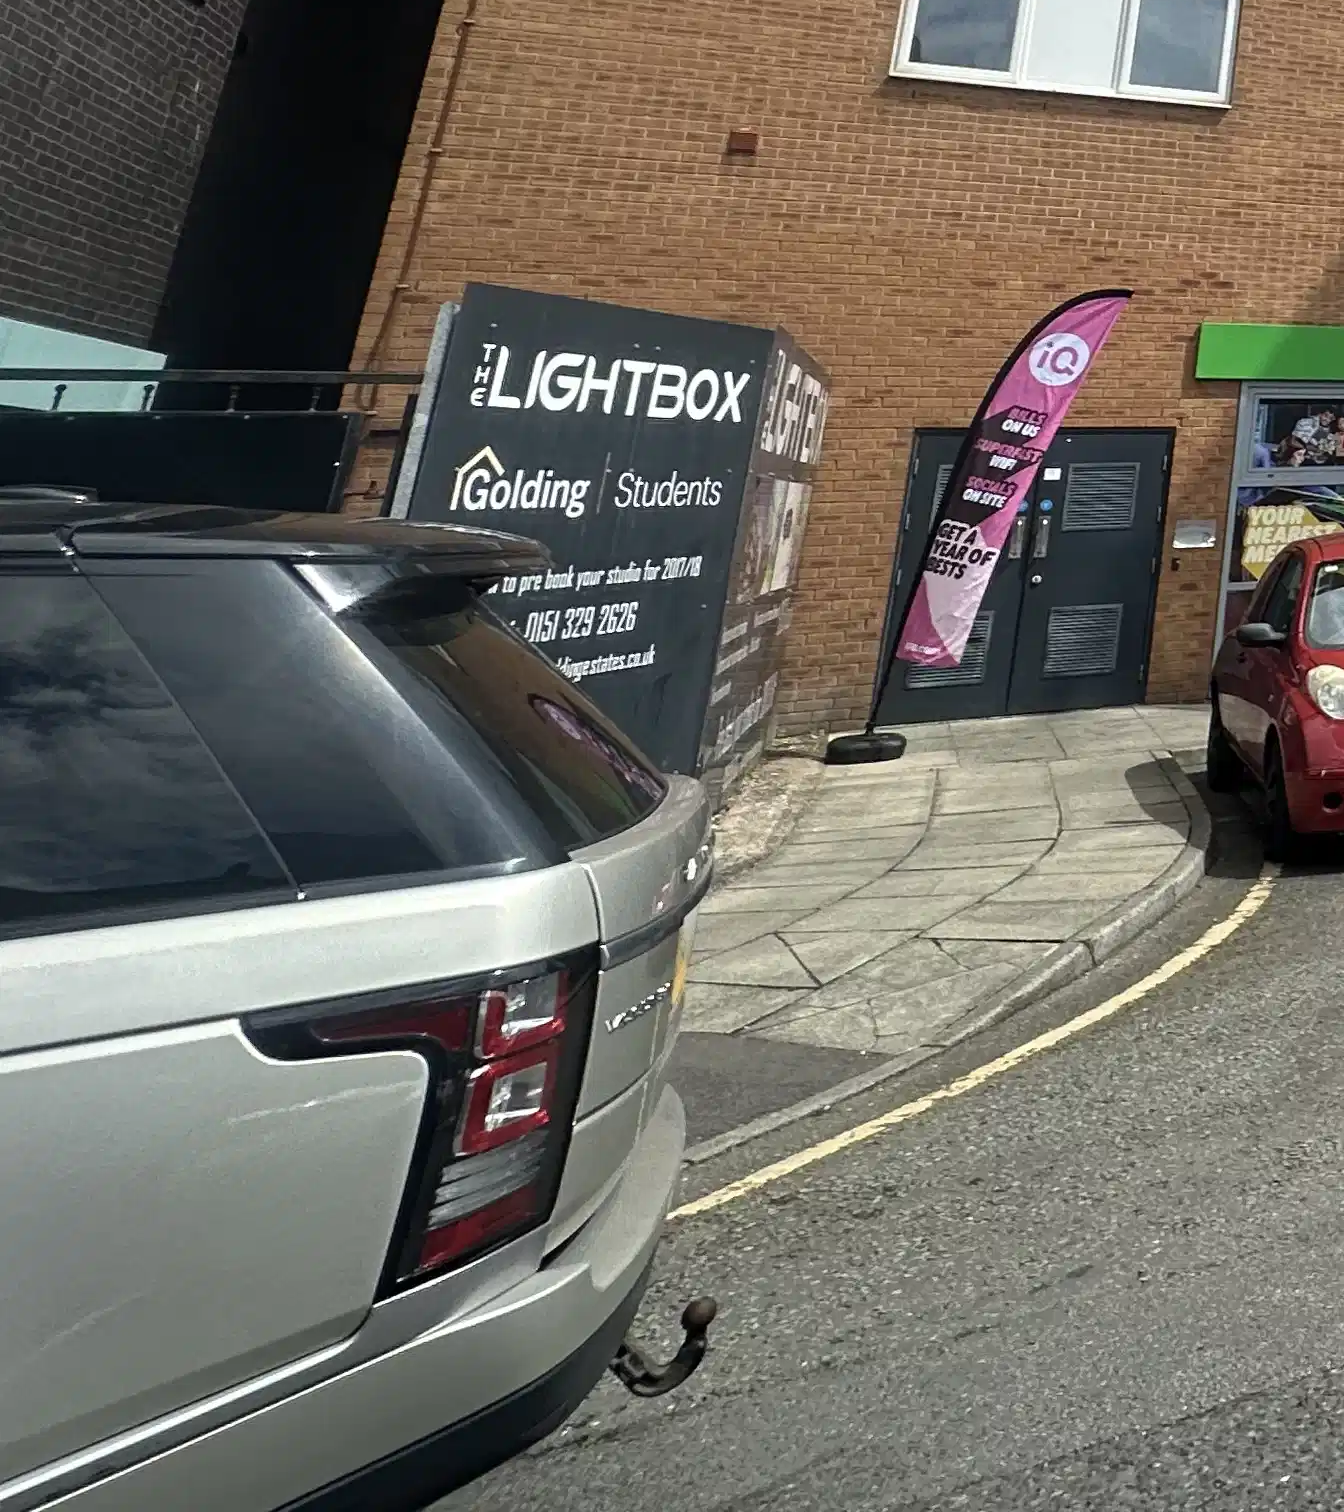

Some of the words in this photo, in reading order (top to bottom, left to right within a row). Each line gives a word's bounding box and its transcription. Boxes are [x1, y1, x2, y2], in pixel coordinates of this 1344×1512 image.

[1036, 340, 1080, 377] iQ
[469, 342, 497, 407] THE
[487, 345, 751, 423] LIGHTBOX
[1001, 419, 1025, 434] ON
[1020, 423, 1041, 438] US
[462, 468, 591, 519] Golding
[613, 470, 723, 508] Students
[978, 491, 1008, 508] SITE
[1247, 506, 1305, 526] YOUR
[937, 522, 968, 542] GET
[962, 529, 978, 546] A
[1245, 524, 1338, 545] NEAREST
[932, 539, 970, 561] YEAR
[967, 548, 997, 567] OF
[501, 575, 518, 594] to
[517, 574, 543, 597] pre
[544, 564, 575, 590] book
[575, 570, 606, 592] your
[606, 560, 642, 585] studio
[642, 558, 661, 581] for
[523, 609, 561, 643] 0151
[560, 606, 596, 640] 329
[596, 601, 639, 635] 2626
